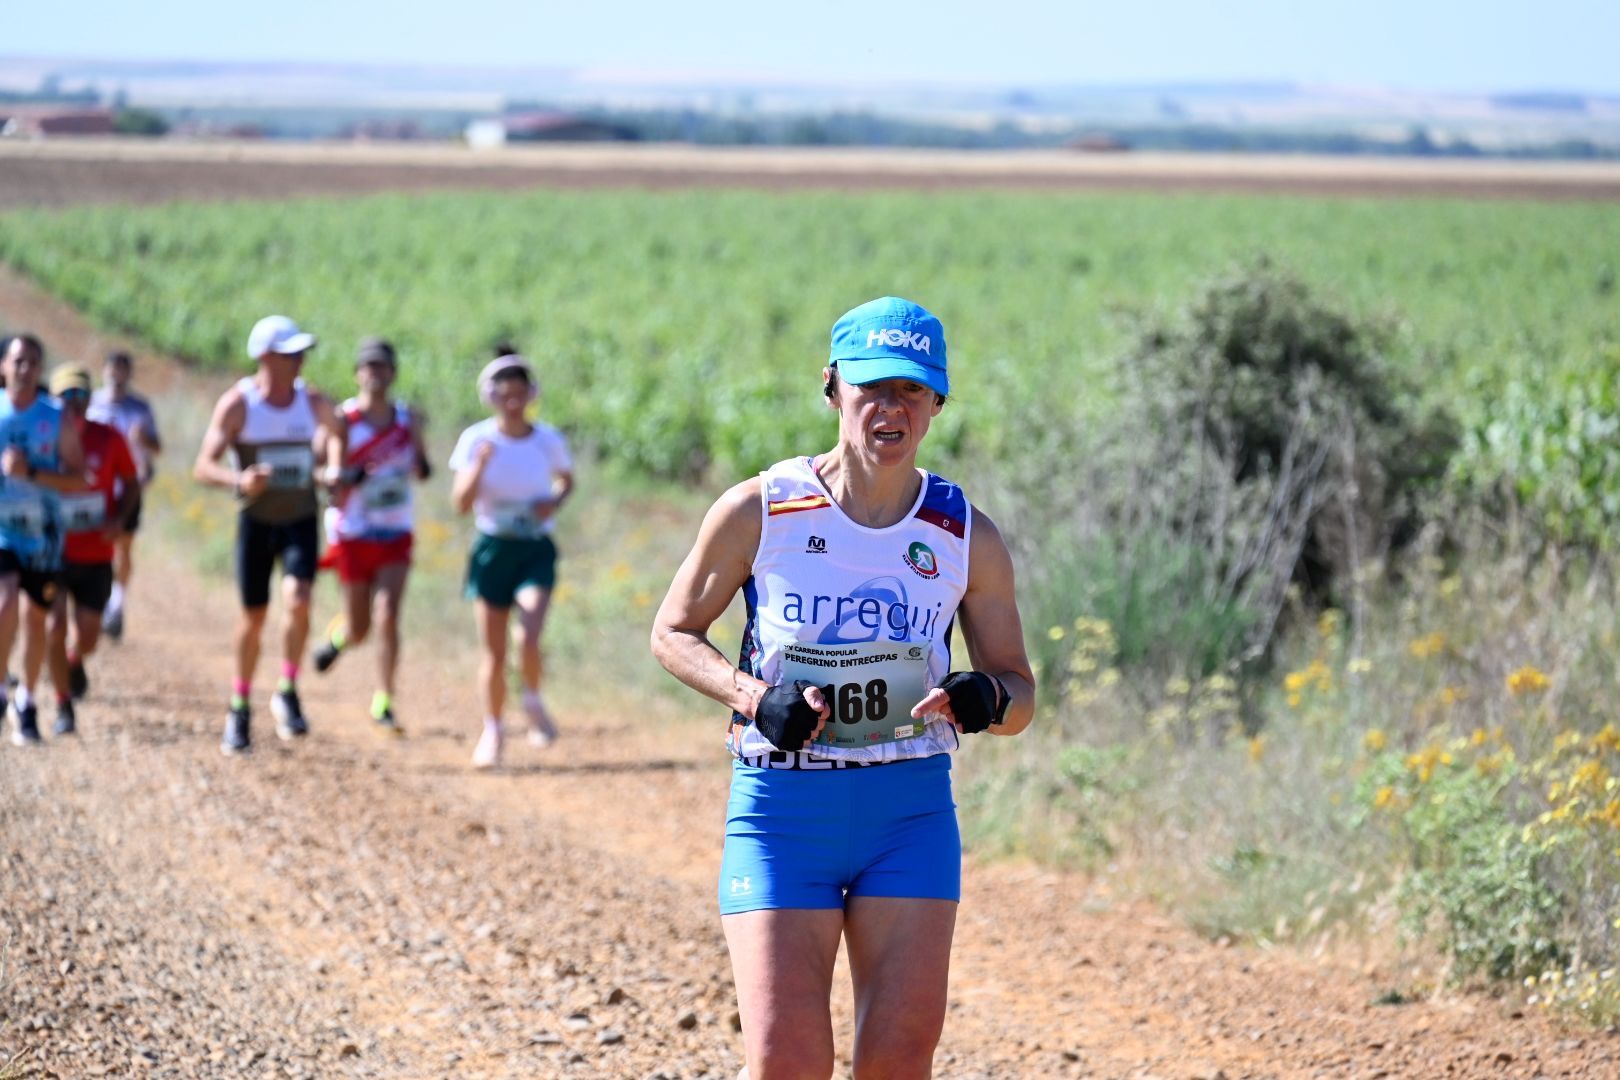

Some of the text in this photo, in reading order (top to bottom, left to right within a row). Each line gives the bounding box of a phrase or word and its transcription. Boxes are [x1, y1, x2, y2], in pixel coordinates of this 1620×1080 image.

[866, 329, 931, 356] HOKA
[783, 592, 942, 641] arregui
[785, 653, 899, 668] PEREGRINO ENTRECEPAS
[794, 646, 825, 656] CARRERA
[820, 679, 888, 724] 168
